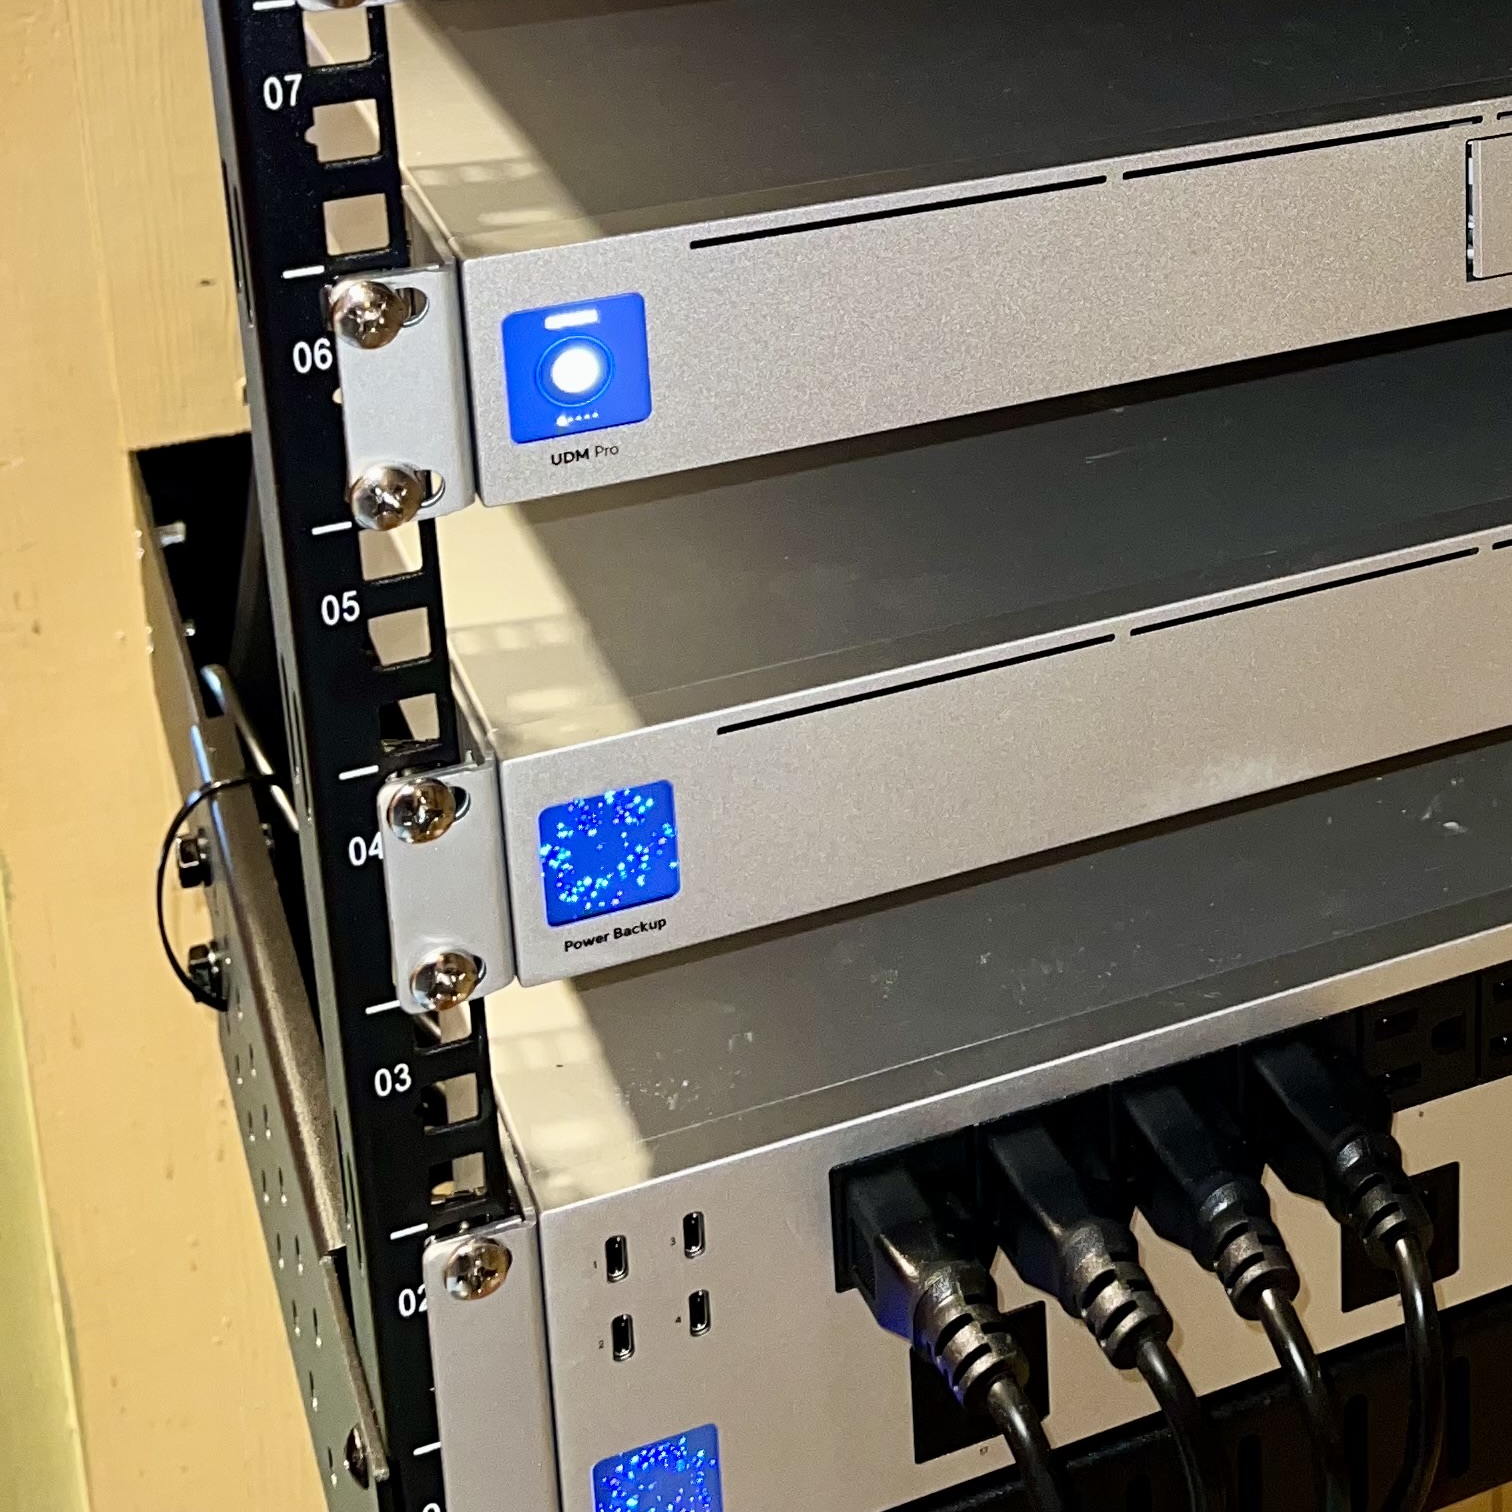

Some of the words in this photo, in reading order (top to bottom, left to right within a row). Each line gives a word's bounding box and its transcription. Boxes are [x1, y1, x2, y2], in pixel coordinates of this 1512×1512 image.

[262, 72, 303, 111] 07
[292, 337, 334, 374] 06
[551, 447, 590, 466] UDM
[595, 445, 619, 458] Pro
[320, 589, 361, 626] 05
[348, 831, 384, 867] 04
[564, 932, 610, 952] Power
[613, 918, 667, 940] Backup
[374, 1062, 412, 1097] 03
